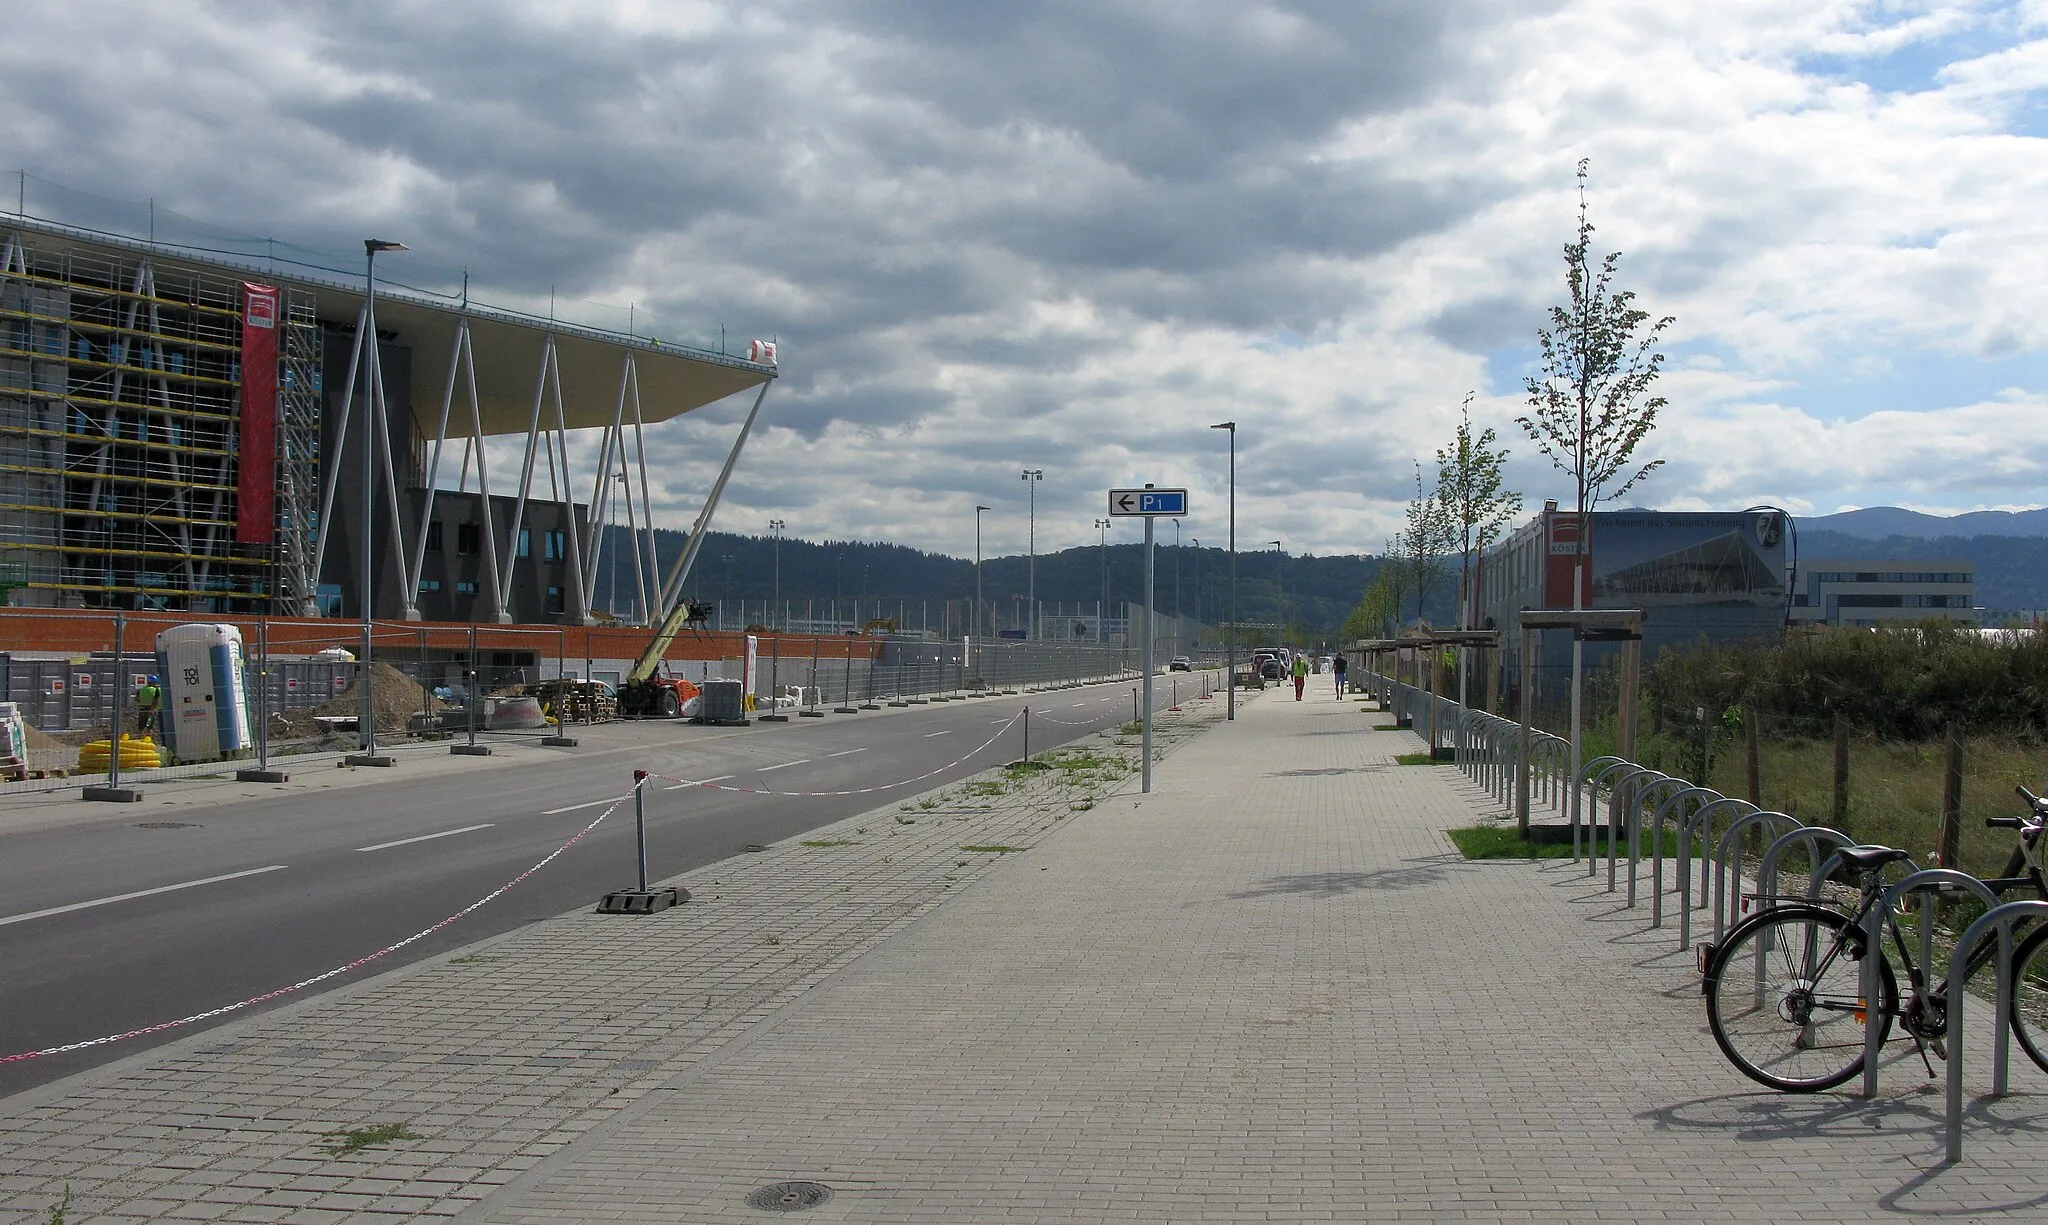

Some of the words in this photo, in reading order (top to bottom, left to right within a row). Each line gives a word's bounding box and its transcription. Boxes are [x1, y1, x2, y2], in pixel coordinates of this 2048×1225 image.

[1143, 495, 1154, 510] P
[1158, 499, 1162, 510] 1
[1551, 543, 1586, 553] KÖSTR
[183, 667, 199, 677] TOI
[184, 676, 200, 686] TOI
